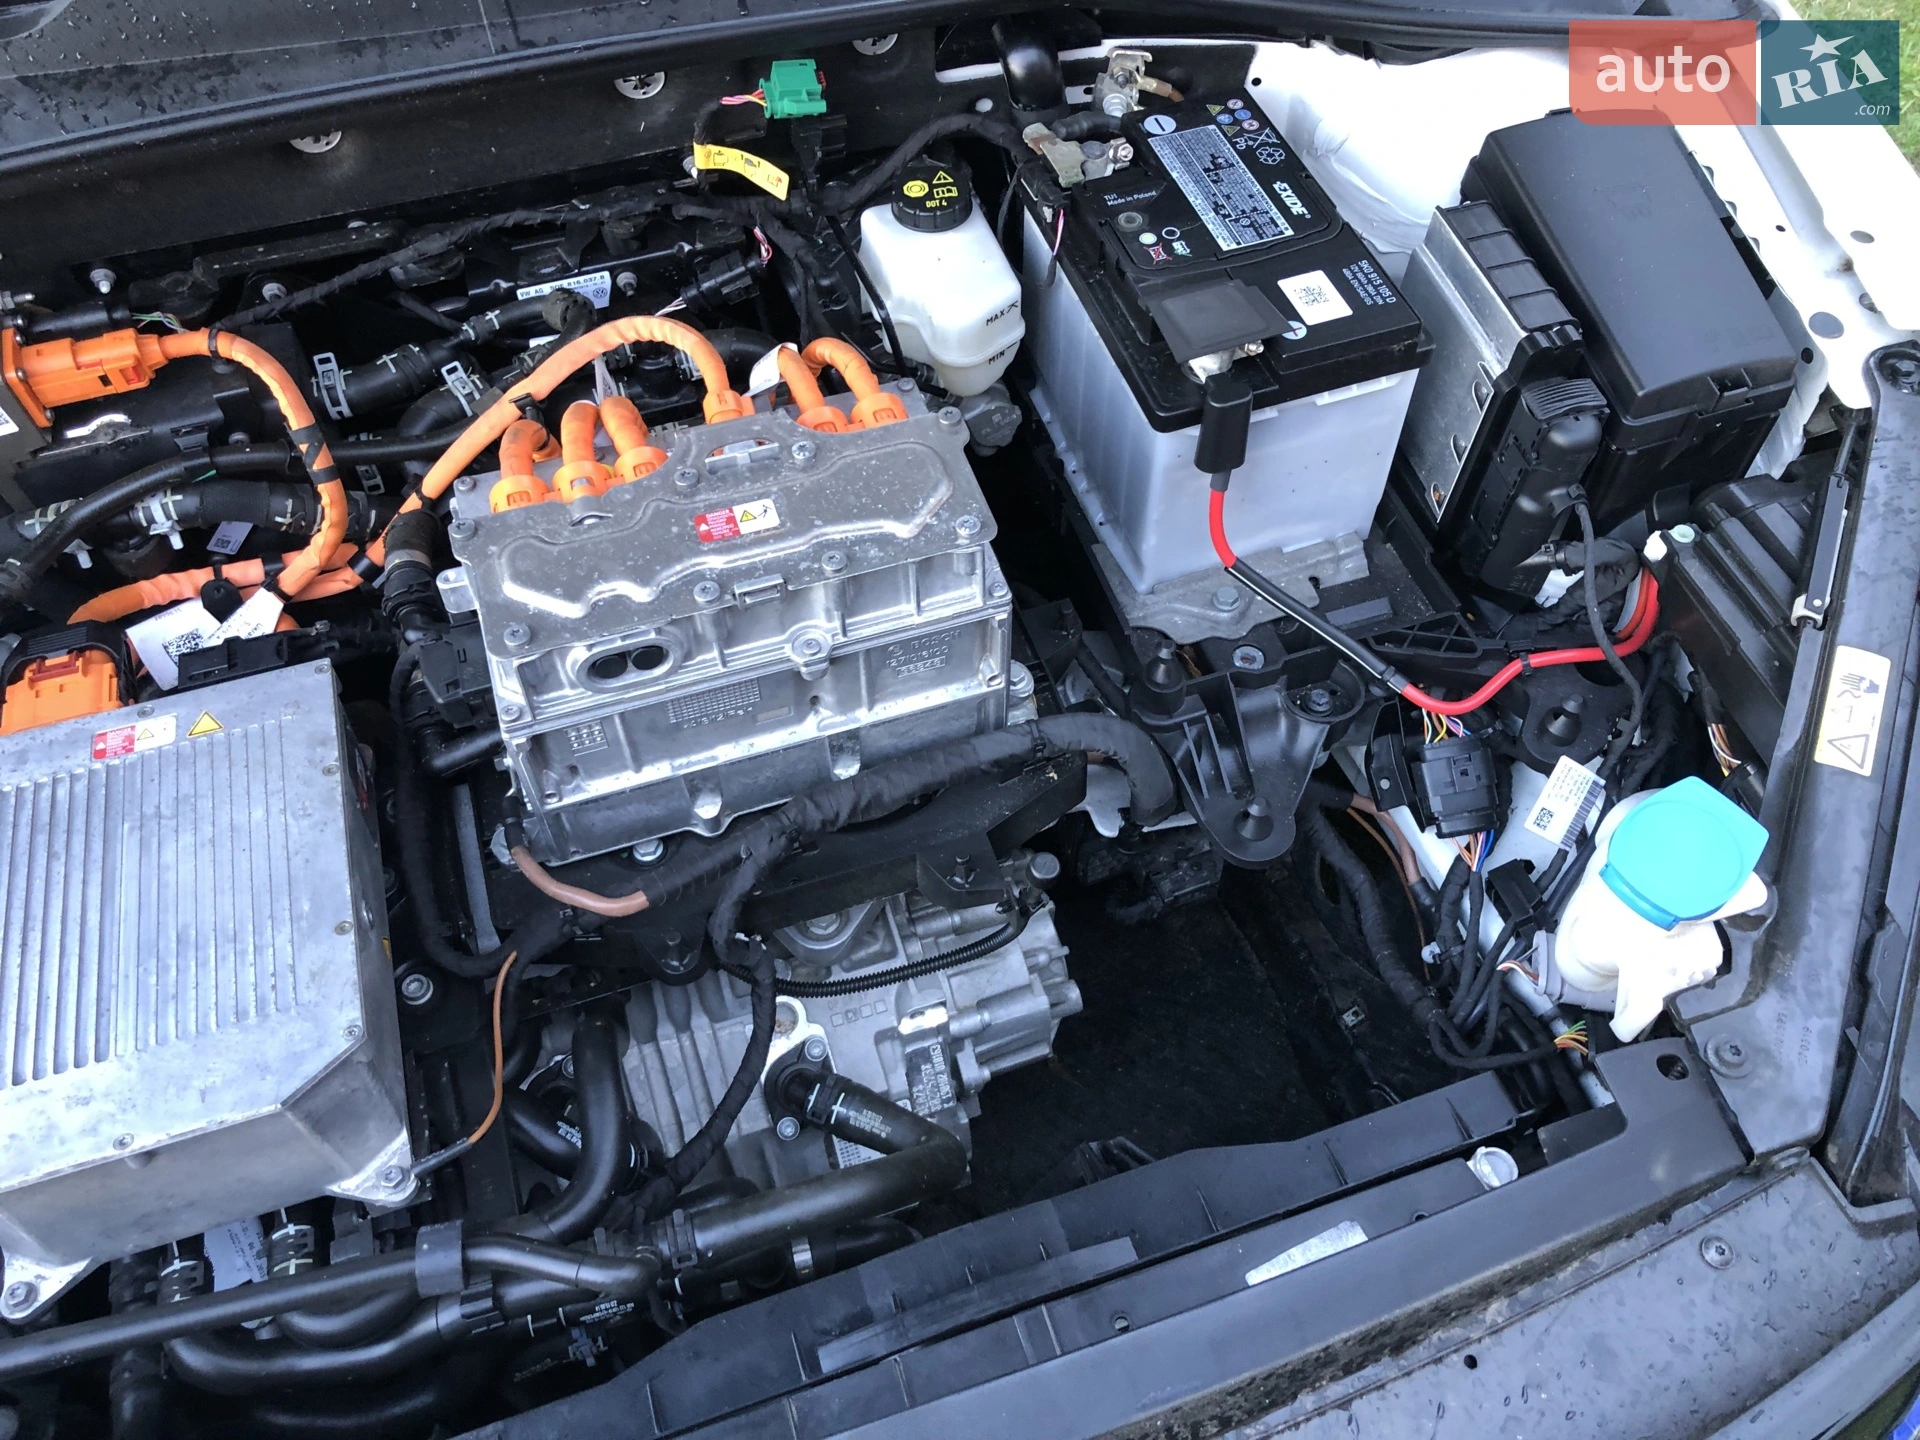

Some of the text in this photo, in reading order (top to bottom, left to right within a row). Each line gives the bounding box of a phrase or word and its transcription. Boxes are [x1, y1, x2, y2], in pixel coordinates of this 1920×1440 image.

[1232, 137, 1247, 150] Pb
[925, 199, 948, 208] DOT 4
[1106, 198, 1126, 207] Made
[1133, 190, 1157, 200] Poland
[1272, 181, 1309, 216] EXIDE
[534, 287, 545, 295] AG
[1368, 272, 1384, 285] 915
[1377, 285, 1393, 298] 105
[1385, 296, 1397, 304] D
[985, 308, 1005, 327] MAX
[988, 349, 1006, 366] MIN
[910, 629, 961, 649] BOSCH
